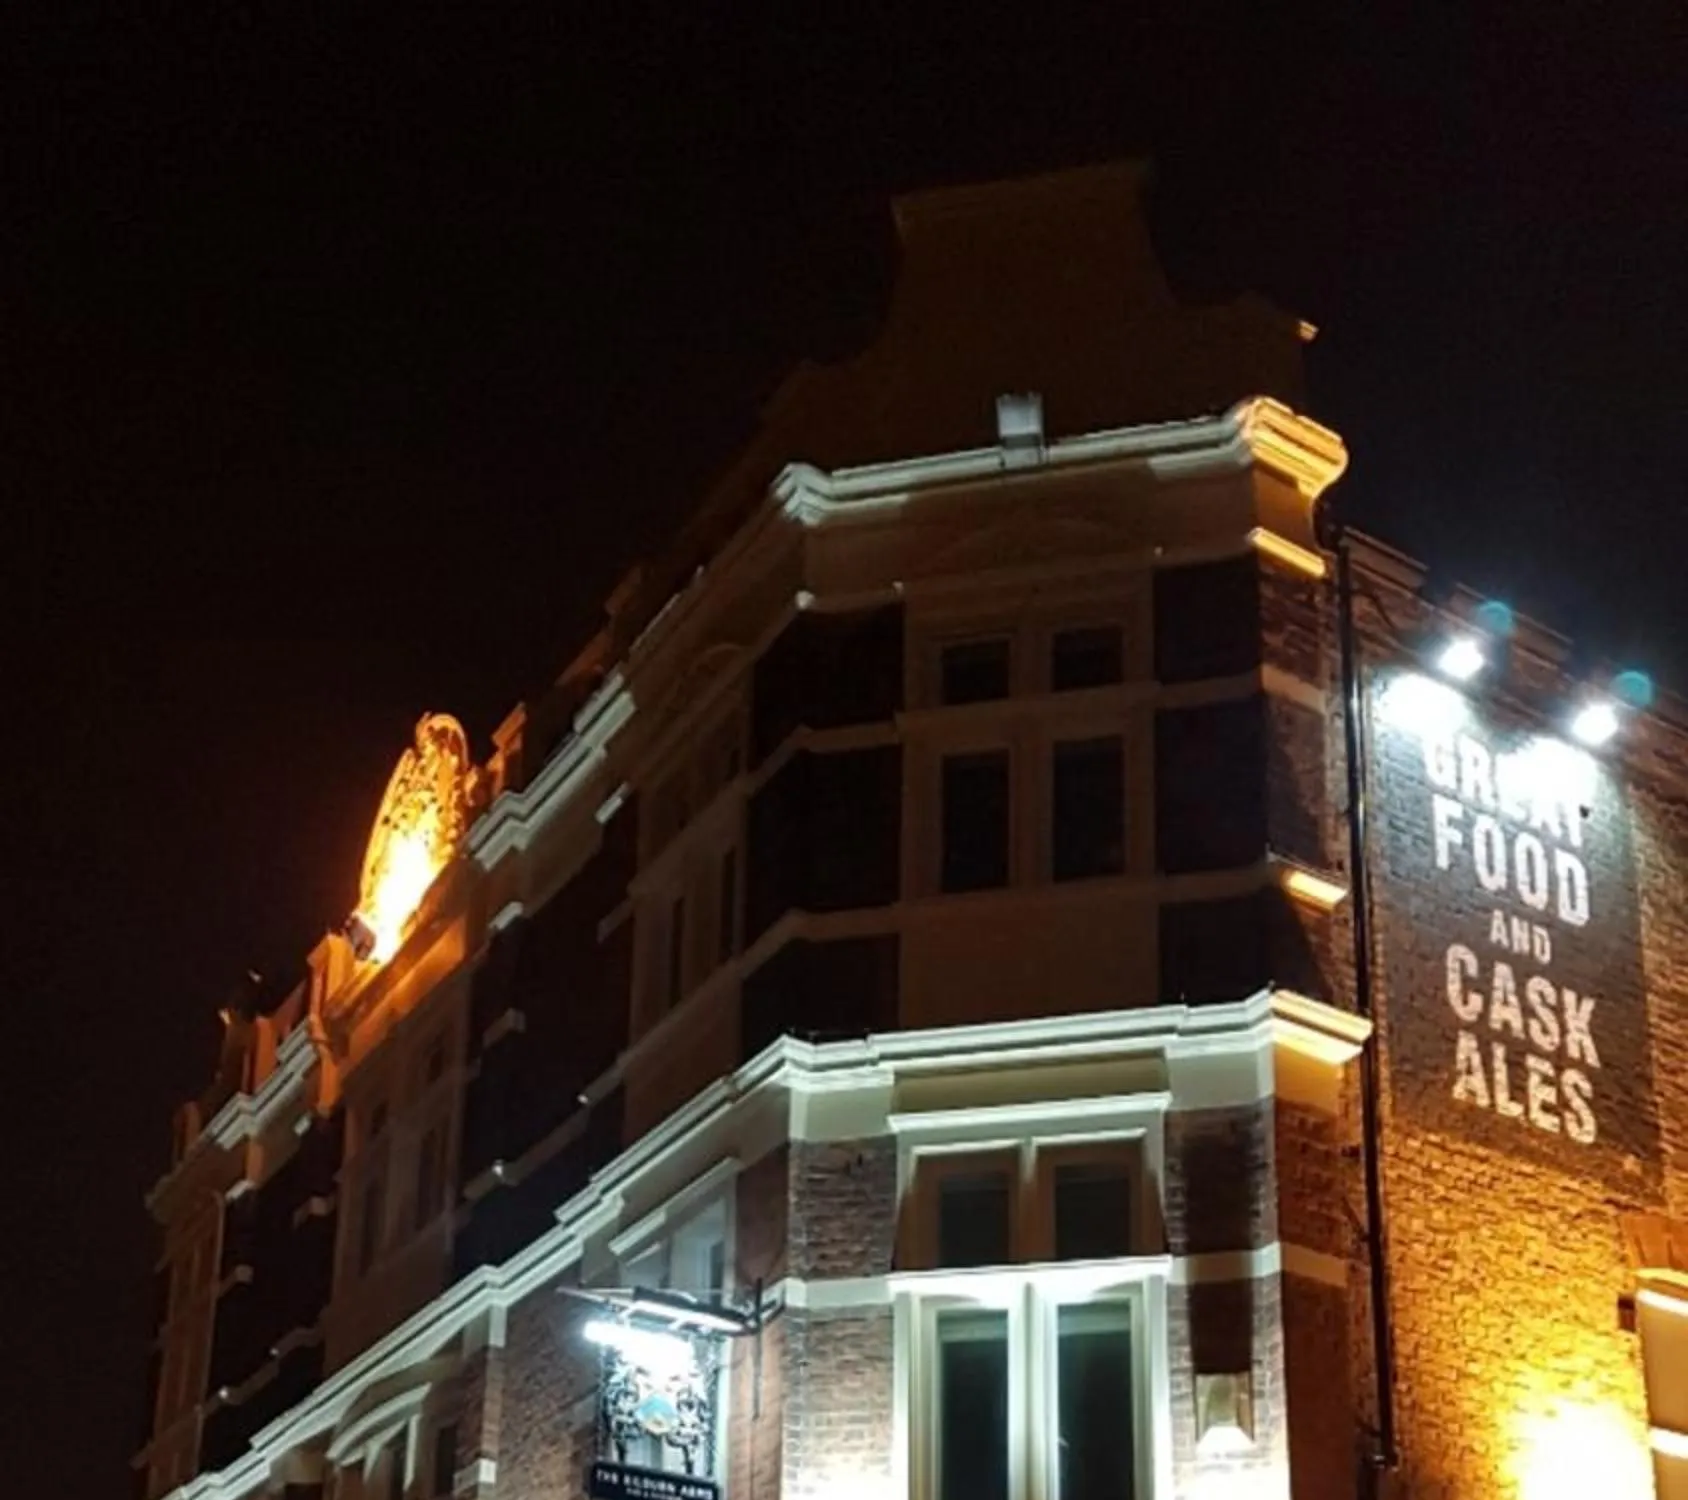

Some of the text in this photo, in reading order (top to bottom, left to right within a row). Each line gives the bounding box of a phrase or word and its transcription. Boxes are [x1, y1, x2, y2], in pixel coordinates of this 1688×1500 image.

[1432, 792, 1589, 928] FOOD
[1489, 909, 1551, 966] AND
[1446, 943, 1600, 1068] CASK
[1452, 1030, 1597, 1144] ALES
